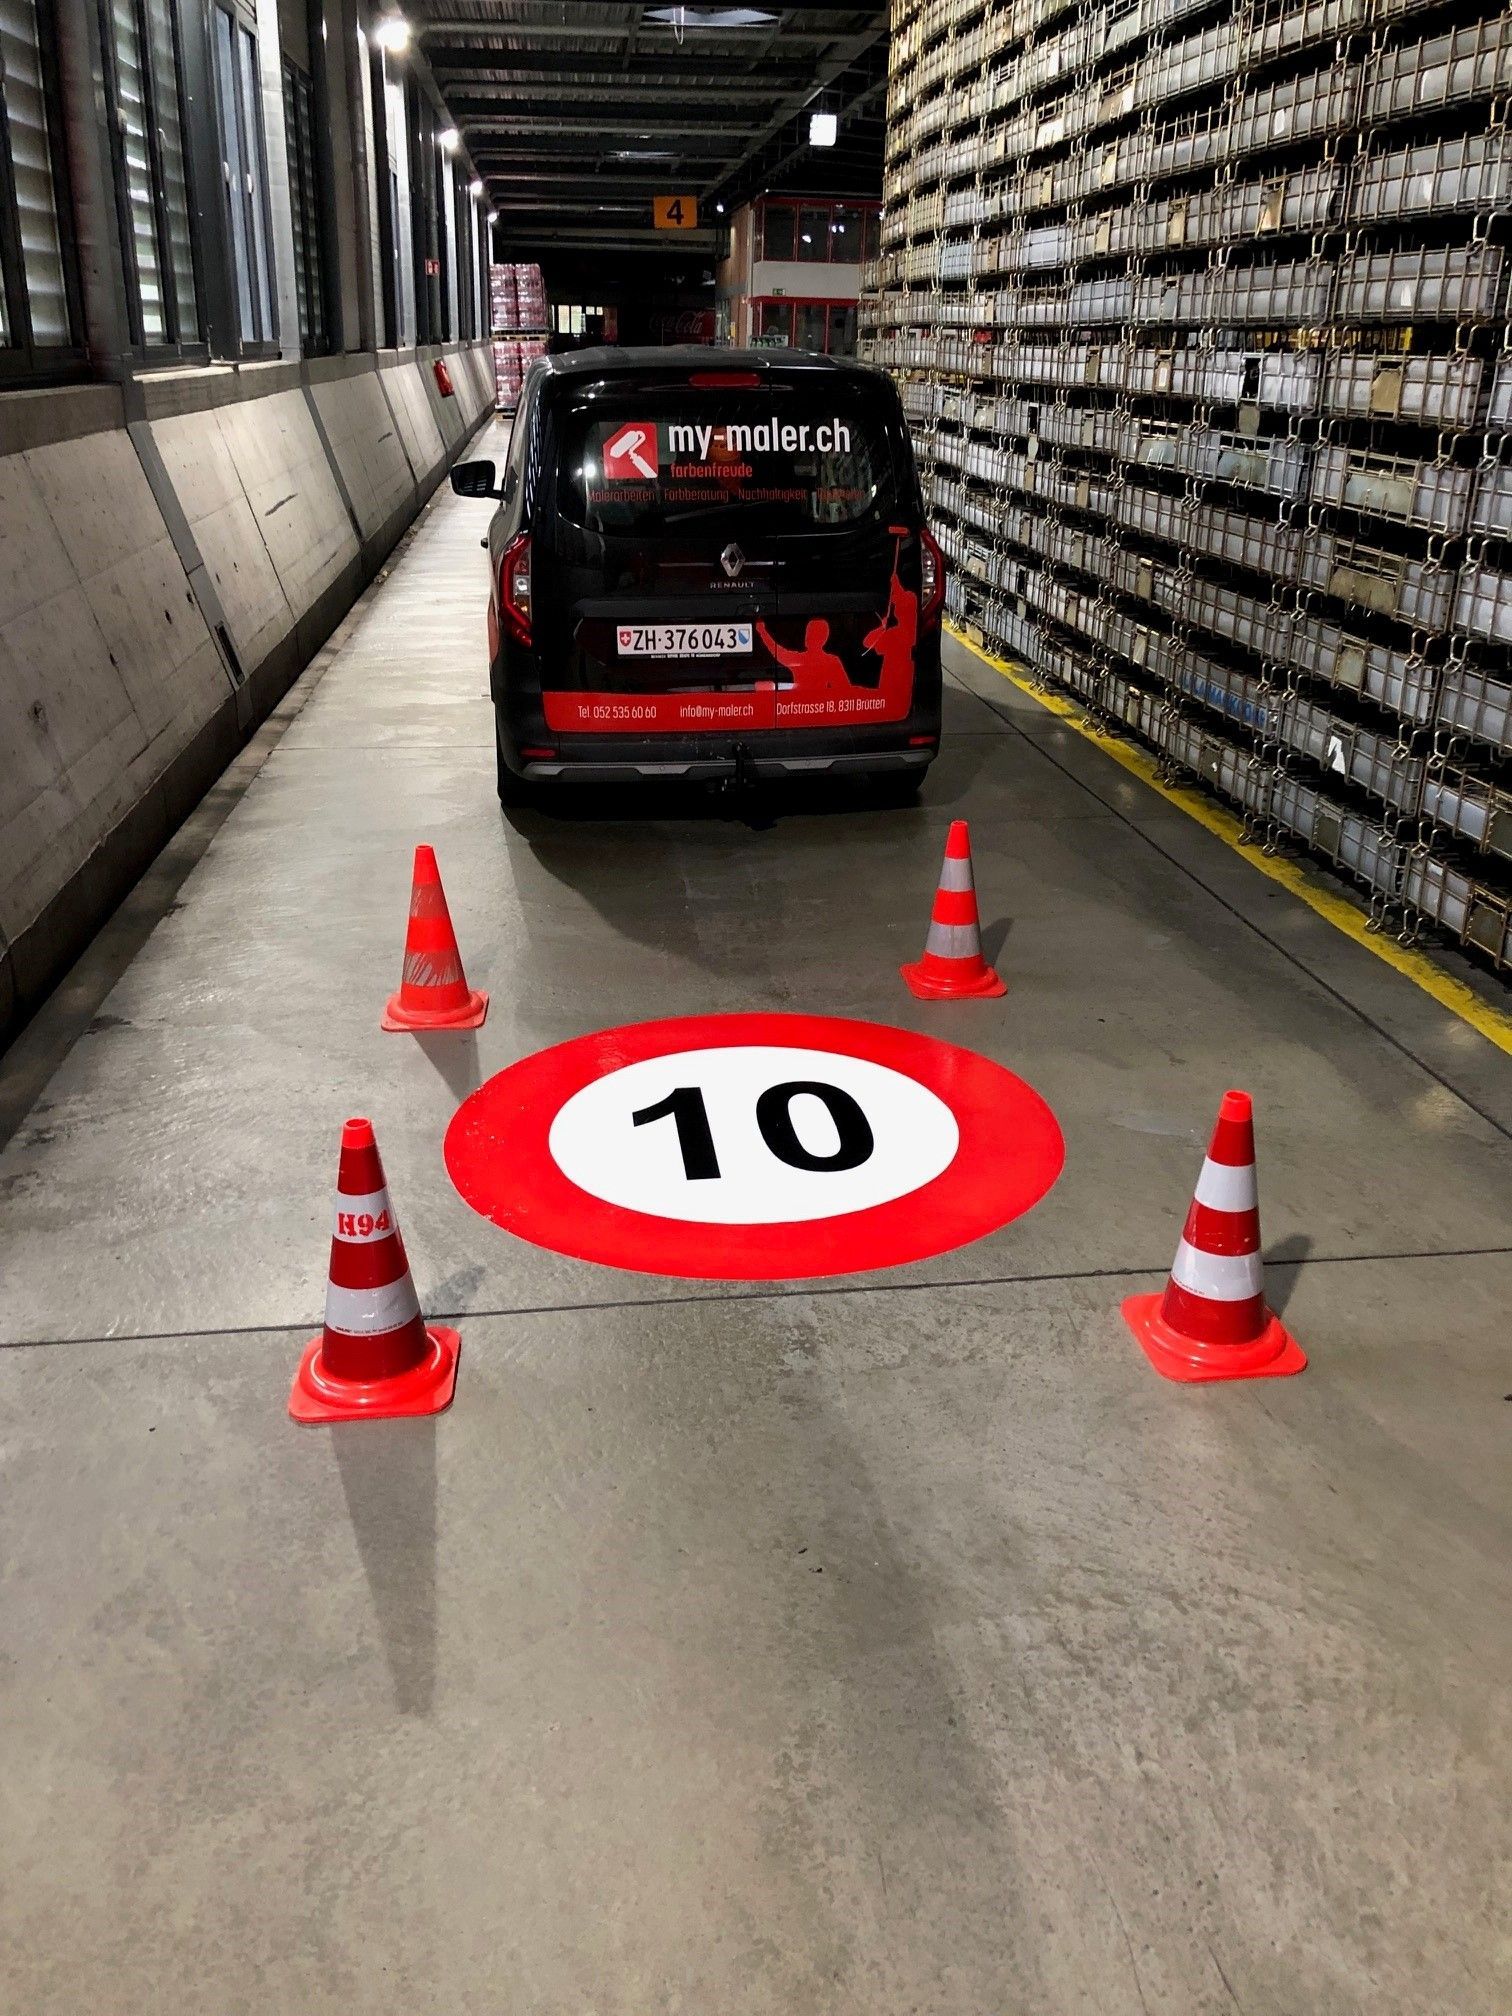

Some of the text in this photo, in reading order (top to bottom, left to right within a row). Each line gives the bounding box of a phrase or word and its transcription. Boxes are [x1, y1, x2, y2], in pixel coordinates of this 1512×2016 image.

[666, 199, 685, 225] 4
[668, 416, 851, 460] my-maler.ch
[670, 463, 753, 478] farbenfreude
[664, 488, 729, 503] Farbberatung
[709, 581, 755, 589] RENAULT
[593, 705, 611, 719] 052
[612, 705, 630, 719] 535
[631, 705, 644, 719] 60
[645, 705, 657, 719] 60
[776, 701, 825, 715] Dorfstrasse
[838, 699, 855, 712] 8311
[632, 1080, 874, 1180] 10
[338, 1209, 390, 1237] H94
